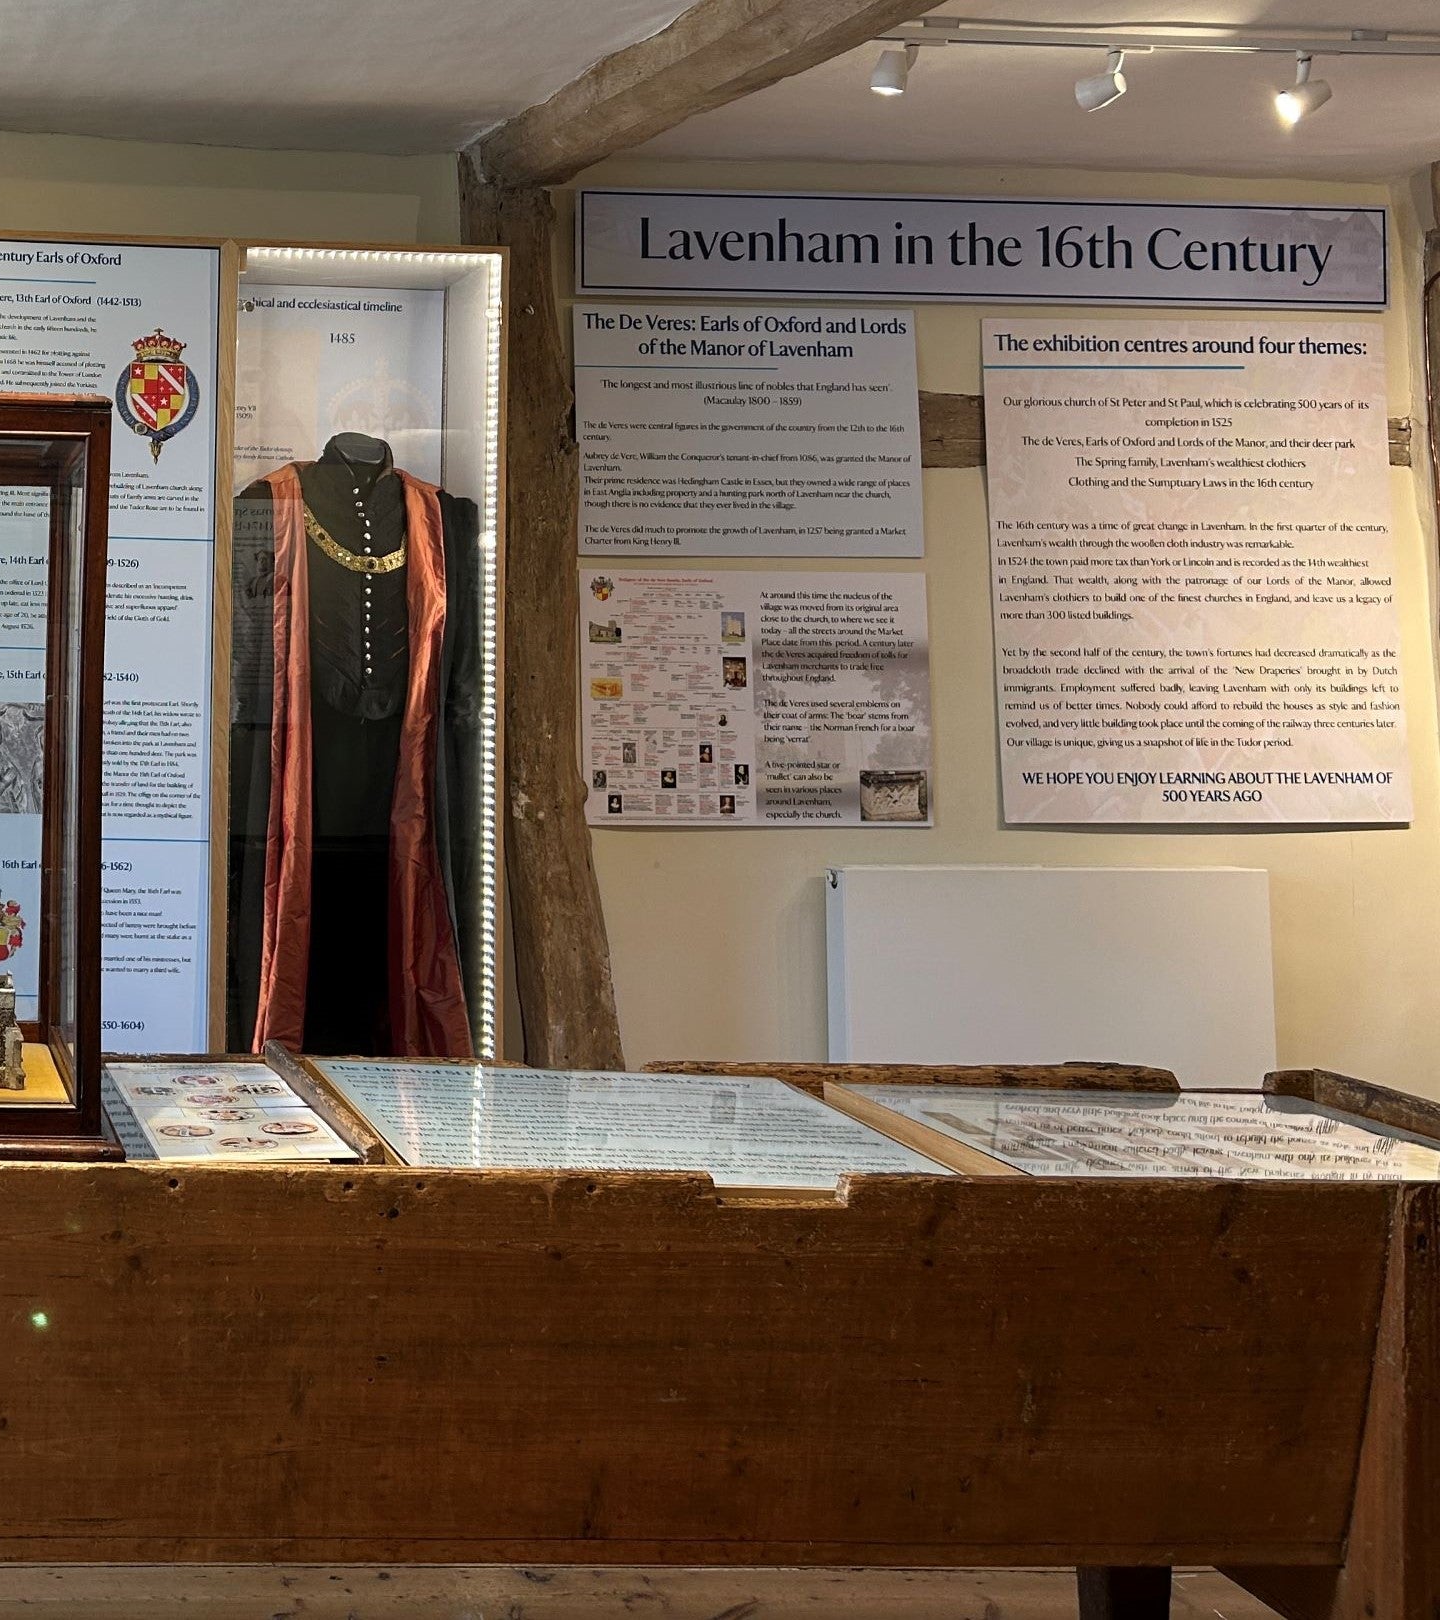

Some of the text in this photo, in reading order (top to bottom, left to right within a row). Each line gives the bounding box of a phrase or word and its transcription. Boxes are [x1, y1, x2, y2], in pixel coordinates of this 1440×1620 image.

[36, 250, 63, 263] Earls
[65, 251, 80, 264] of
[79, 252, 121, 265] Oxford
[640, 216, 1333, 286] Lavenham in the 16th Century
[15, 293, 33, 302] 13th
[34, 294, 50, 303] Earl
[51, 294, 62, 304] of
[61, 295, 94, 305] Oxford
[96, 296, 141, 307] (1442-1513)
[276, 297, 296, 308] and
[296, 298, 361, 310] ecclesiastical
[362, 300, 403, 312] timeline
[582, 312, 906, 334] The De Veres: Earls of Oxford and Lords
[329, 332, 356, 344] 1485
[994, 333, 1367, 355] The exhibition centres around four themes:
[638, 337, 853, 357] of the Manor of Lavenham
[619, 378, 652, 392] longest
[652, 379, 669, 389] and
[695, 379, 736, 394] illustrious
[738, 381, 753, 390] line
[755, 381, 765, 390] of
[765, 381, 796, 391] nobles
[796, 381, 814, 393] that
[815, 382, 850, 393] England
[851, 382, 867, 391] has
[703, 395, 746, 407] (Macaulay
[748, 395, 770, 406] 1800
[779, 396, 802, 407] 1859)
[1002, 396, 1369, 411] Our glorious church of St Peter and St Paul, which is celebrating 500 years of its
[1144, 416, 1199, 429] completion
[1211, 417, 1233, 427] 1525
[1074, 456, 1093, 466] The
[1094, 456, 1126, 469] Spring
[1216, 457, 1264, 467] wealthiest
[1265, 457, 1306, 468] clothiers
[1068, 476, 1314, 490] Clothing and the Sumptuary Laws in the 16th century
[9, 555, 26, 564] 14th
[28, 555, 46, 565] Earl
[759, 590, 892, 600] At around this time the nucleus of the
[5, 669, 23, 679] 15th
[25, 670, 43, 679] Earl
[1021, 771, 1394, 787] WE HOPE YOU ENJOY LEARNING ABOUT THE LAVENHAM OF
[1162, 789, 1262, 802] 500 YEARS AGO
[2, 859, 19, 868] 16th
[21, 860, 39, 869] Earl
